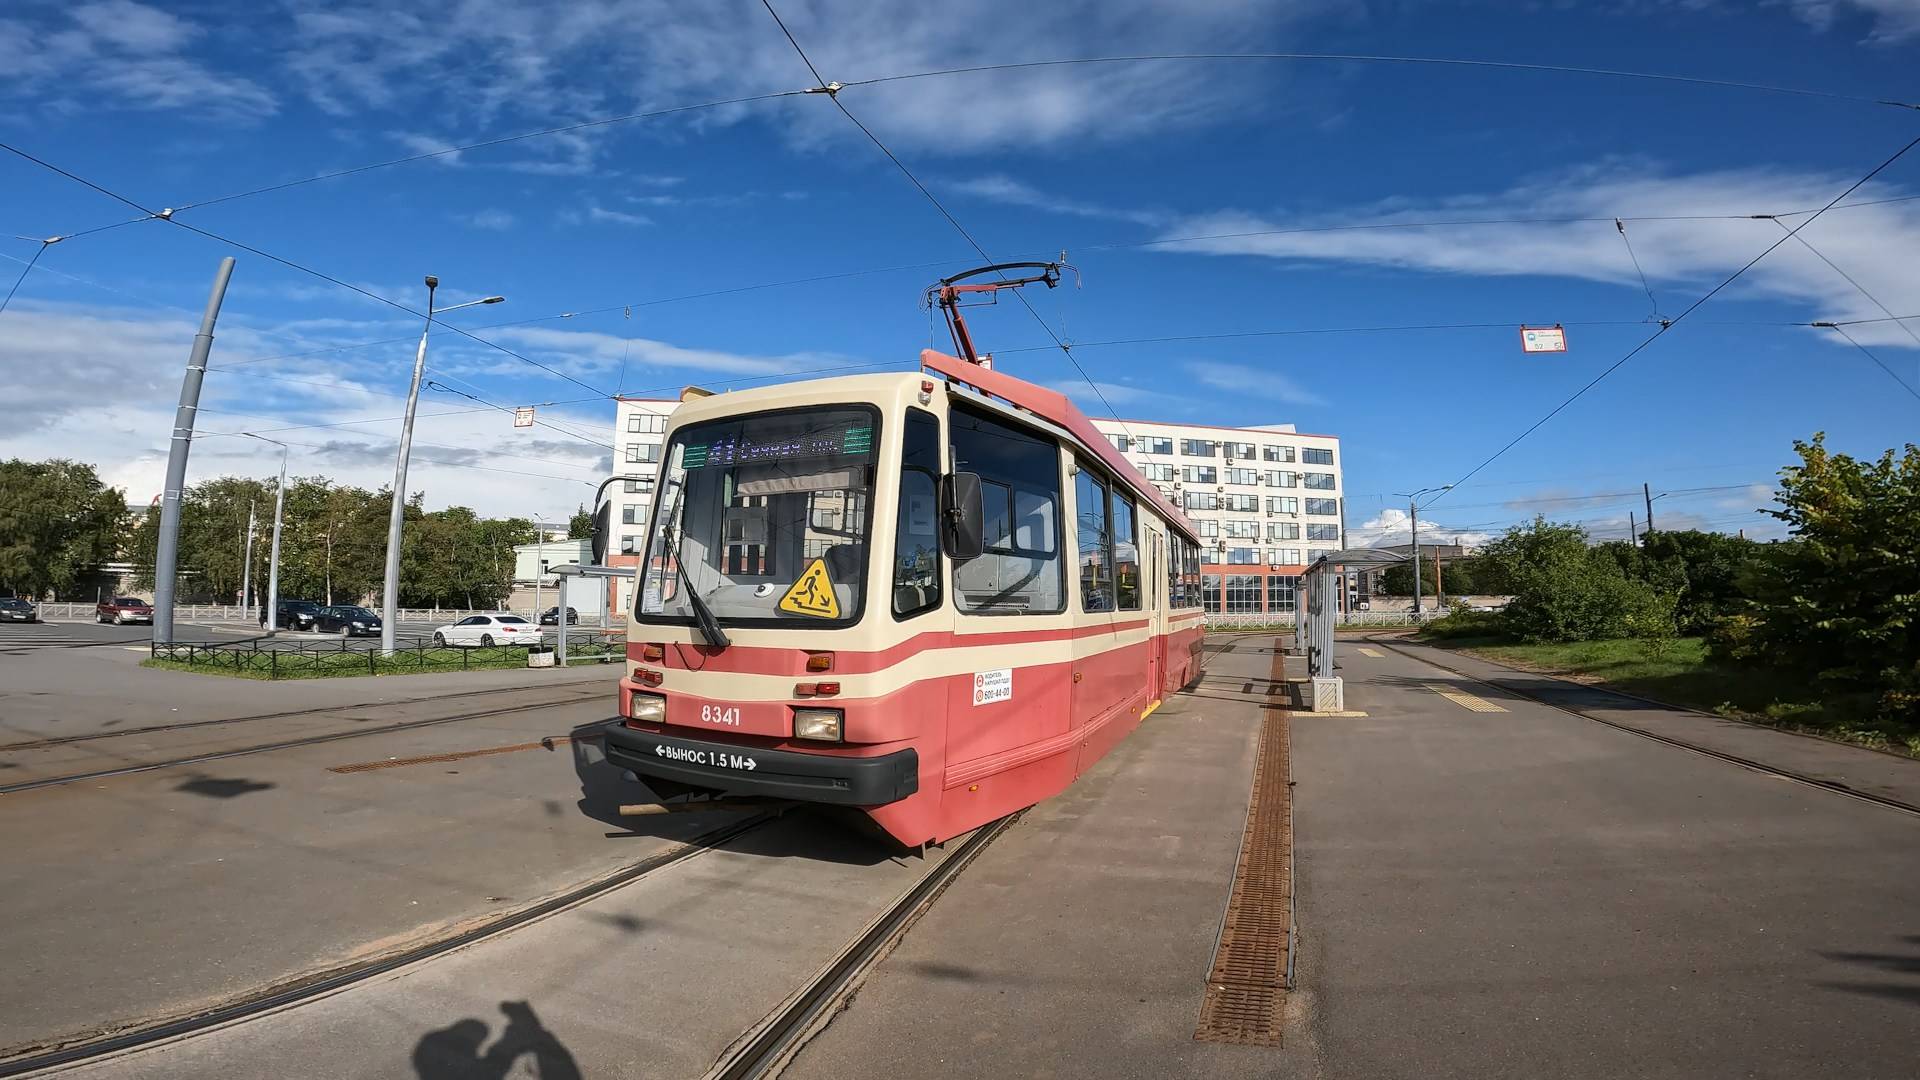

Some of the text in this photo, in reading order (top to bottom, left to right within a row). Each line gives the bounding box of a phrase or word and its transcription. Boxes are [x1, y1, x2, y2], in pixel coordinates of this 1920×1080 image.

[701, 704, 740, 726] 8341
[666, 746, 743, 769] ВЫНОС 1.5 М
